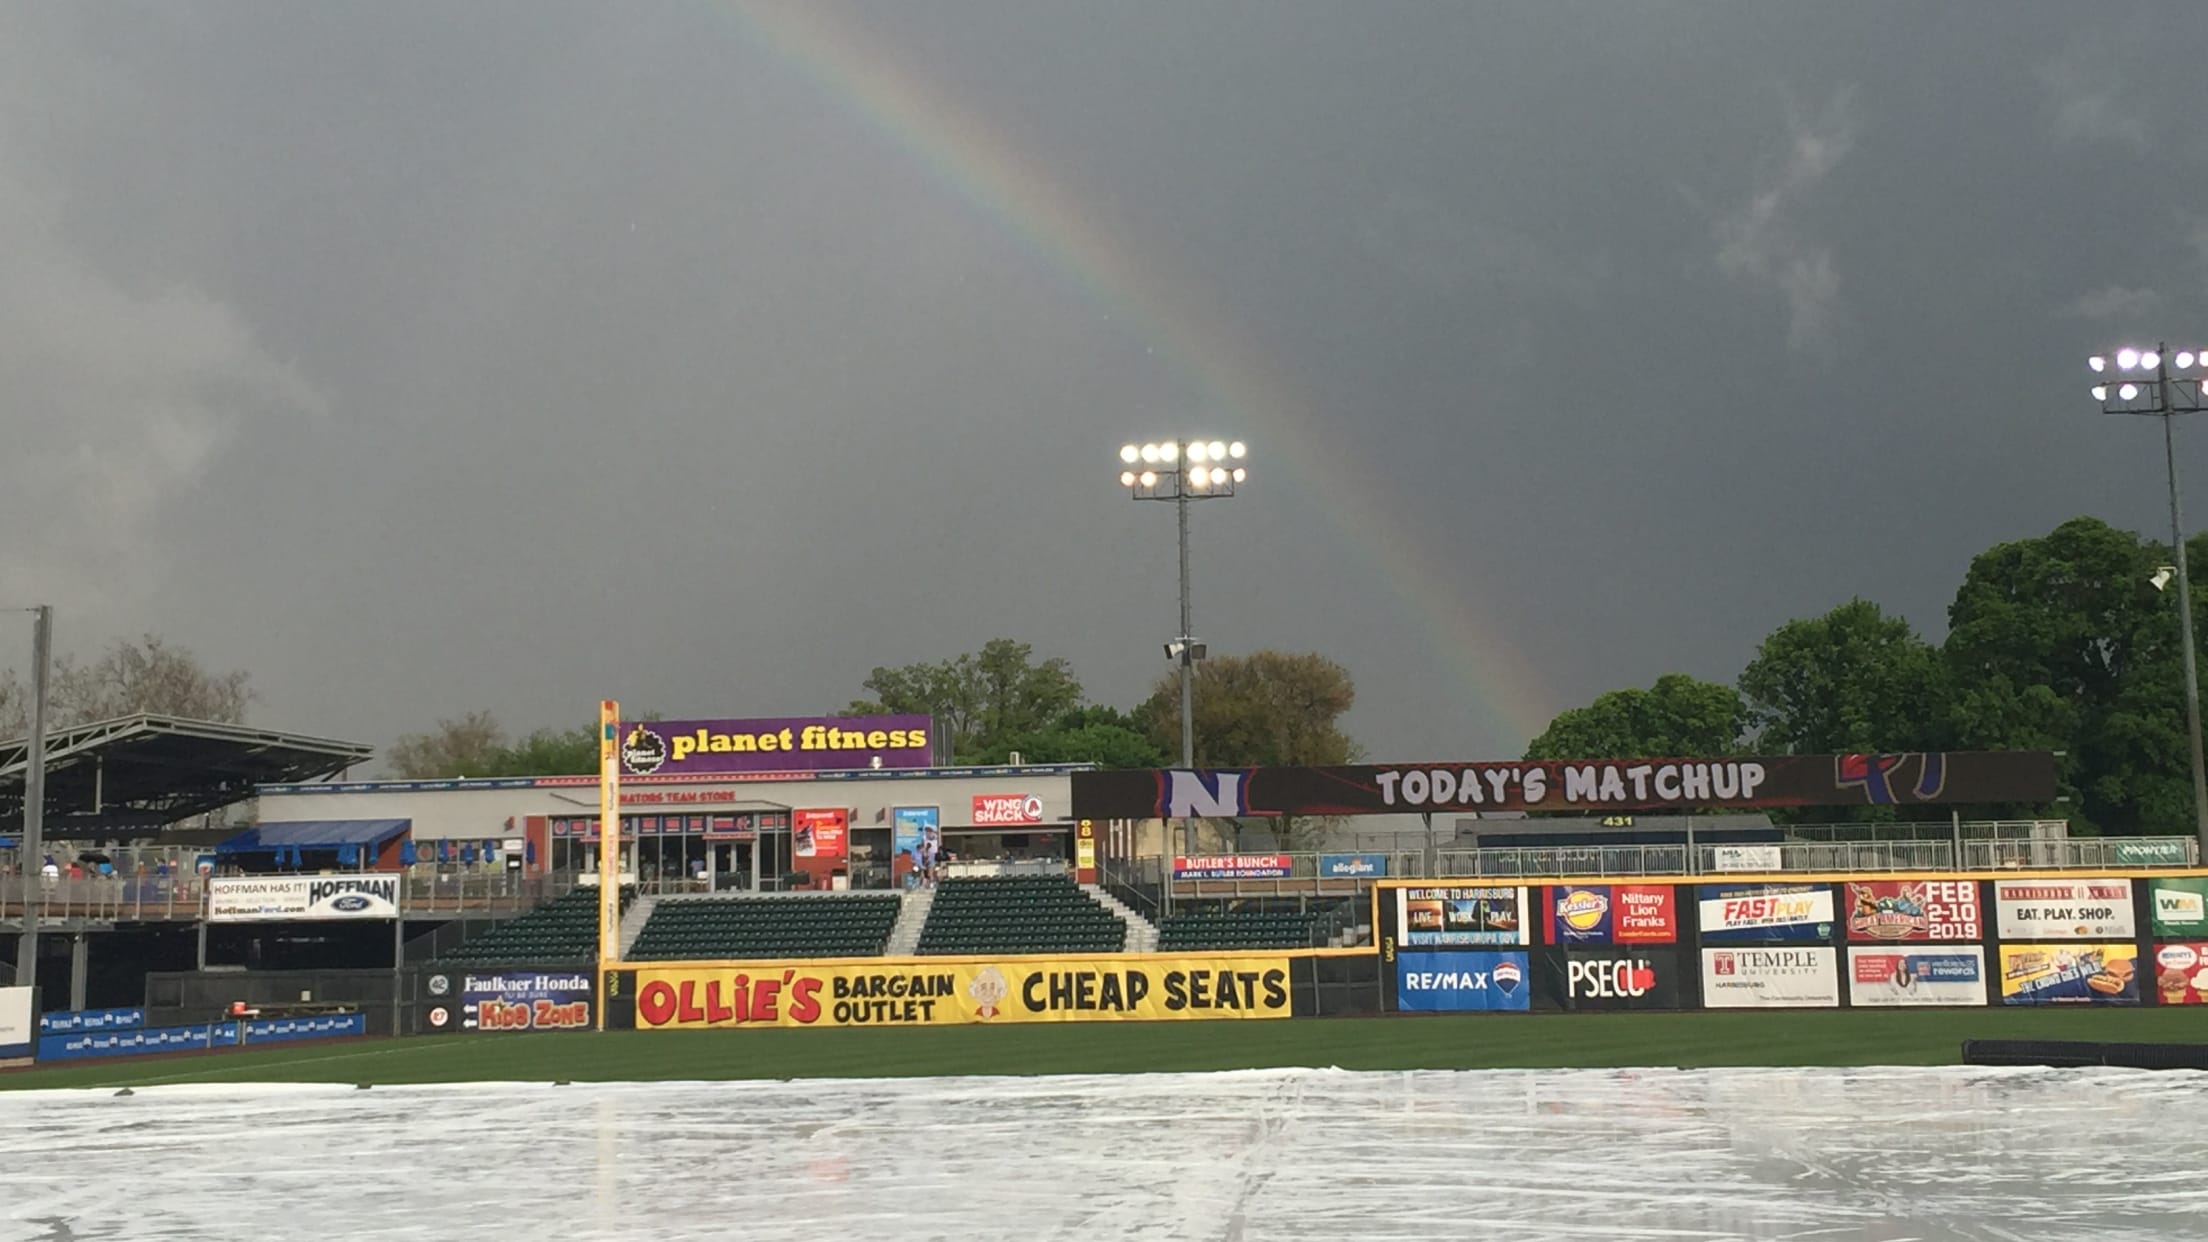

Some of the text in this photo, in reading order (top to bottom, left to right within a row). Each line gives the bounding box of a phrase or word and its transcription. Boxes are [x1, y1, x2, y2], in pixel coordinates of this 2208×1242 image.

[671, 725, 927, 760] planet fitness
[1376, 763, 1766, 805] TODAY'S MATCHUP
[618, 790, 736, 803] NATORS TEAM STORE
[1168, 770, 1240, 817] N
[983, 799, 1021, 810] WING
[975, 810, 1024, 822] SHACK
[1603, 816, 1632, 827] 431
[1186, 857, 1278, 869] BUTLER'S BUNCH
[1332, 862, 1374, 875] allegiant
[1236, 869, 1284, 877] FOUNDATION
[214, 883, 307, 894] HOFFMAN HAS IT!
[309, 880, 396, 907] HOFFMAN
[1408, 888, 1515, 900] WELCOME TO HARRISBURG
[1926, 881, 1974, 902] FEB
[337, 898, 364, 909] Ford
[1622, 893, 1665, 906] Nittany
[2160, 898, 2196, 909] WM
[1560, 900, 1605, 913] Kessler's
[1630, 906, 1657, 915] Lion
[1927, 904, 1976, 922] 2-10
[1413, 912, 1432, 922] LIVE
[2017, 907, 2116, 920] EAT. PLAY. SHOP.
[1623, 916, 1665, 927] Franks
[1929, 923, 1978, 939] 2019
[1737, 952, 1818, 967] TEMPLE
[432, 979, 446, 990] 42
[464, 975, 589, 991] Faulkner Honda
[1406, 972, 1488, 990] RE/MAX
[1567, 959, 1645, 998] PSECU
[832, 974, 954, 999] BARGAIN
[1022, 968, 1287, 1012] CHEAP SEATS
[832, 1000, 936, 1023] OUTLET
